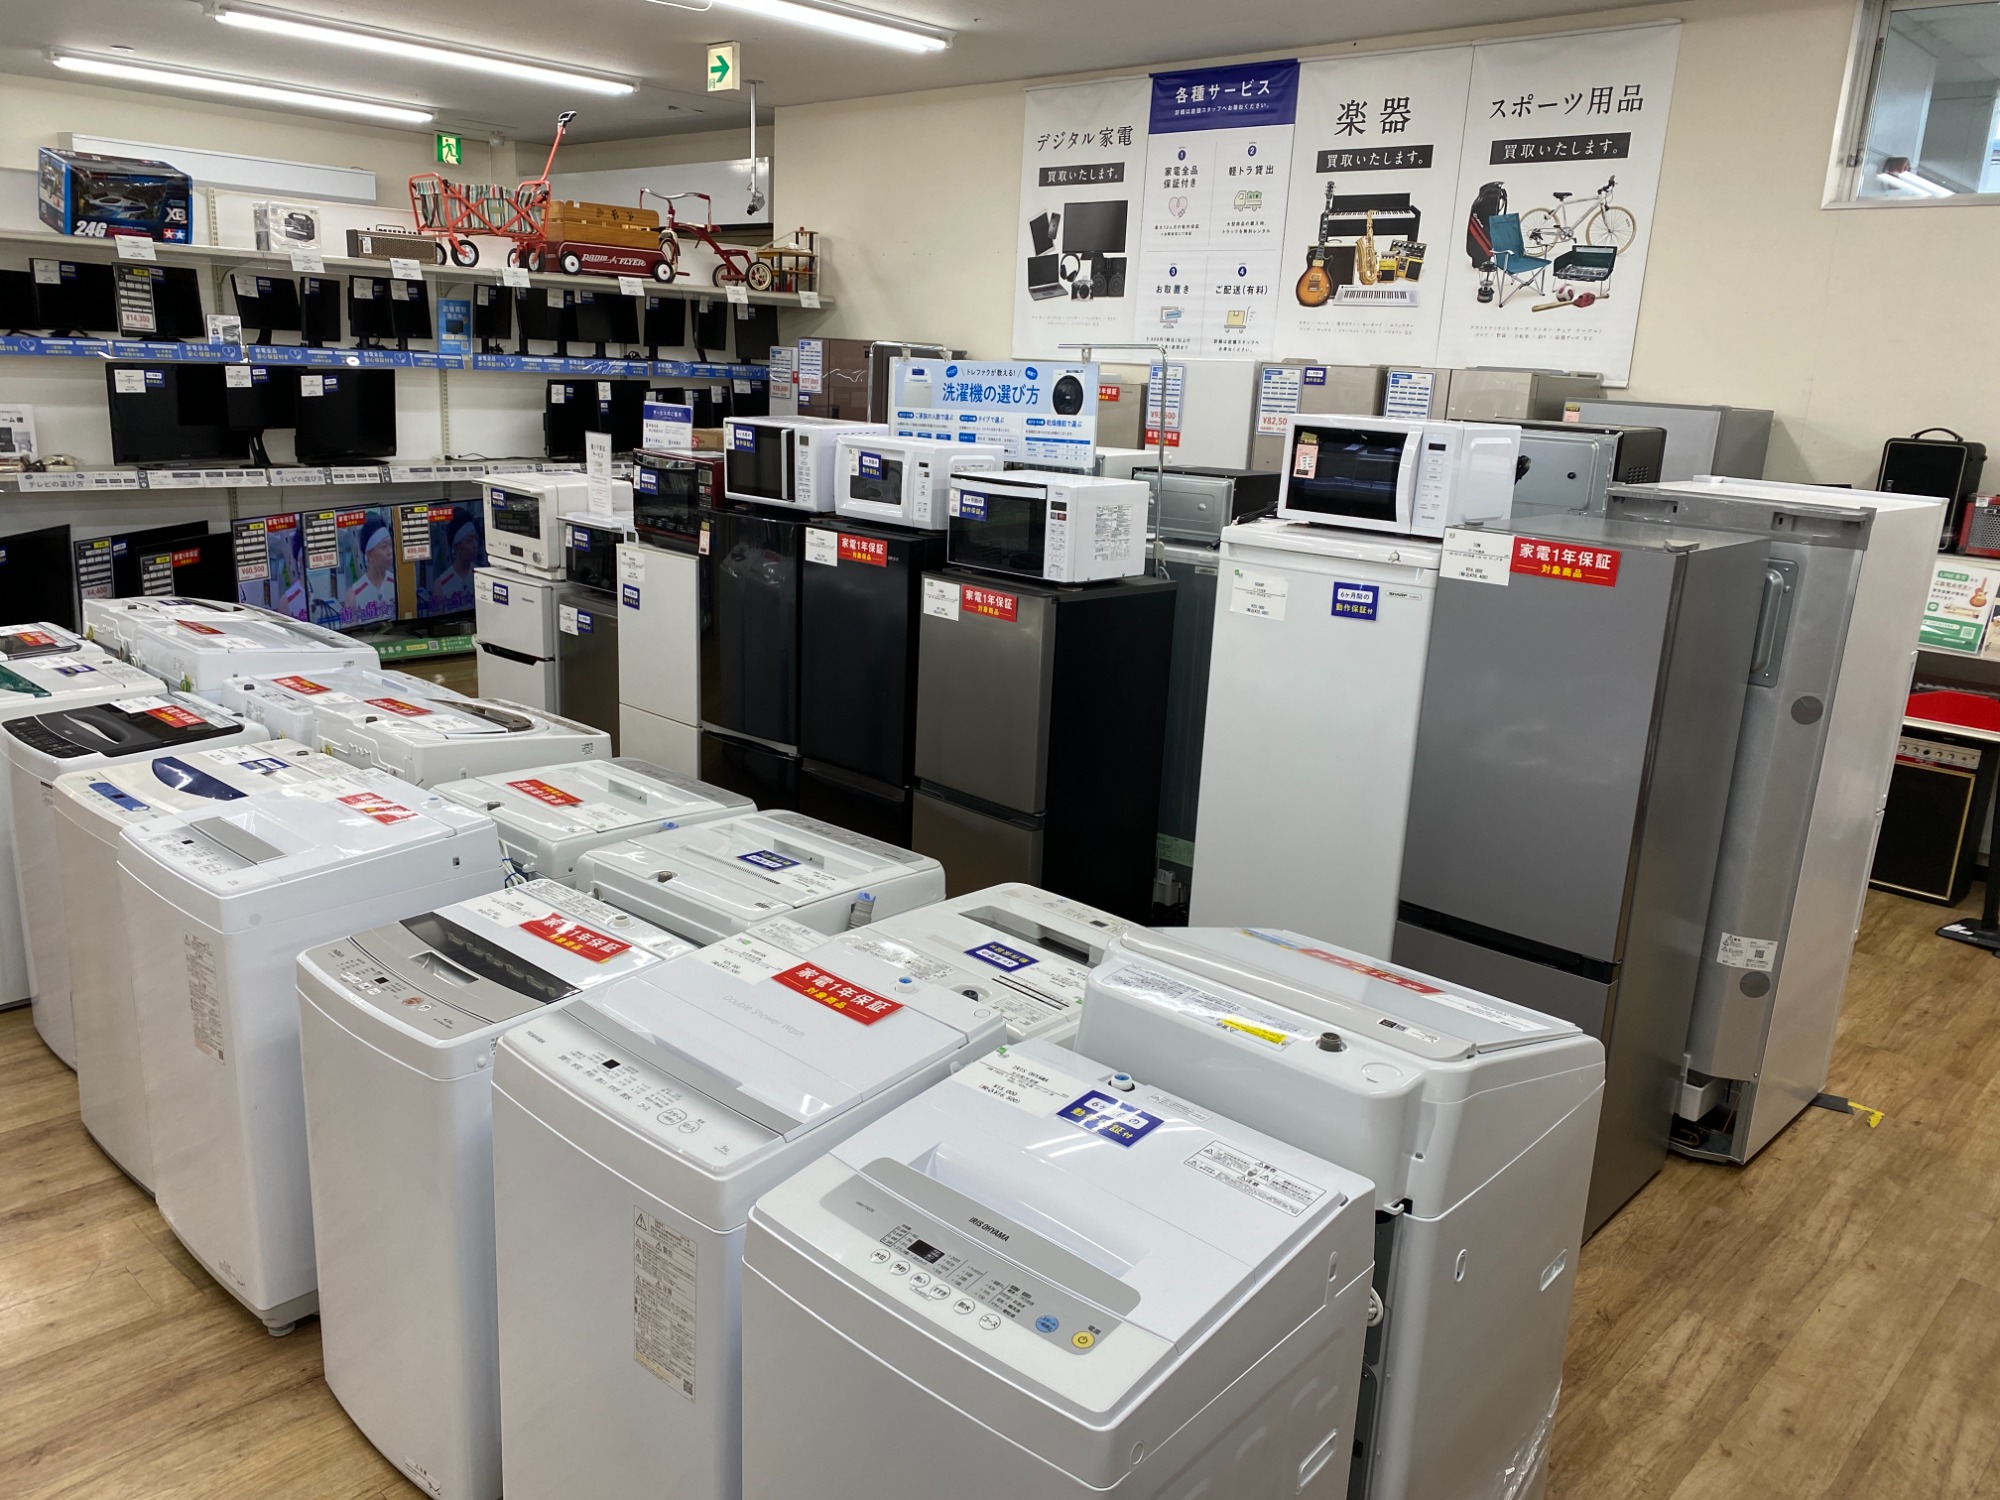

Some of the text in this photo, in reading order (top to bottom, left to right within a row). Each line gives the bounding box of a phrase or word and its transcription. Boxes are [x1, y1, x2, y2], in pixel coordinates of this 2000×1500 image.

[1175, 79, 1270, 104] 各種サービス
[1489, 83, 1644, 119] スポーツ用品
[1333, 96, 1411, 137] 楽器
[1037, 125, 1133, 152] デジタル家電
[1503, 139, 1620, 159] 買取いたします。
[1326, 150, 1425, 169] 買取いたします。
[1046, 167, 1119, 184] 買取いたします。
[1164, 165, 1199, 177] 家電全品
[1228, 164, 1274, 177] 軽トラ貸出
[1163, 178, 1196, 189] 保証付き
[618, 258, 647, 267] FLYER
[1155, 284, 1190, 295] お取置き
[1215, 284, 1268, 296] ご配送(有料)
[942, 382, 1041, 405] 洗濯機の選び方
[1262, 416, 1288, 426] ¥82,50
[841, 537, 884, 555] 家電1年保証
[1519, 543, 1612, 570] 家電1年保証
[1541, 563, 1583, 579] 対象商品
[965, 589, 1013, 610] 家電1年保証
[1340, 590, 1370, 601] 6ヶ月間の
[1335, 602, 1374, 615] 動作保証付
[541, 916, 623, 954] 家1年保証
[795, 967, 892, 1013] 家電1年保証
[803, 986, 848, 1009] 対象商品
[722, 994, 806, 1039] Double Shower Wash
[968, 1216, 1011, 1243] IRIS OHYAMA
[981, 1315, 999, 1328] コース
